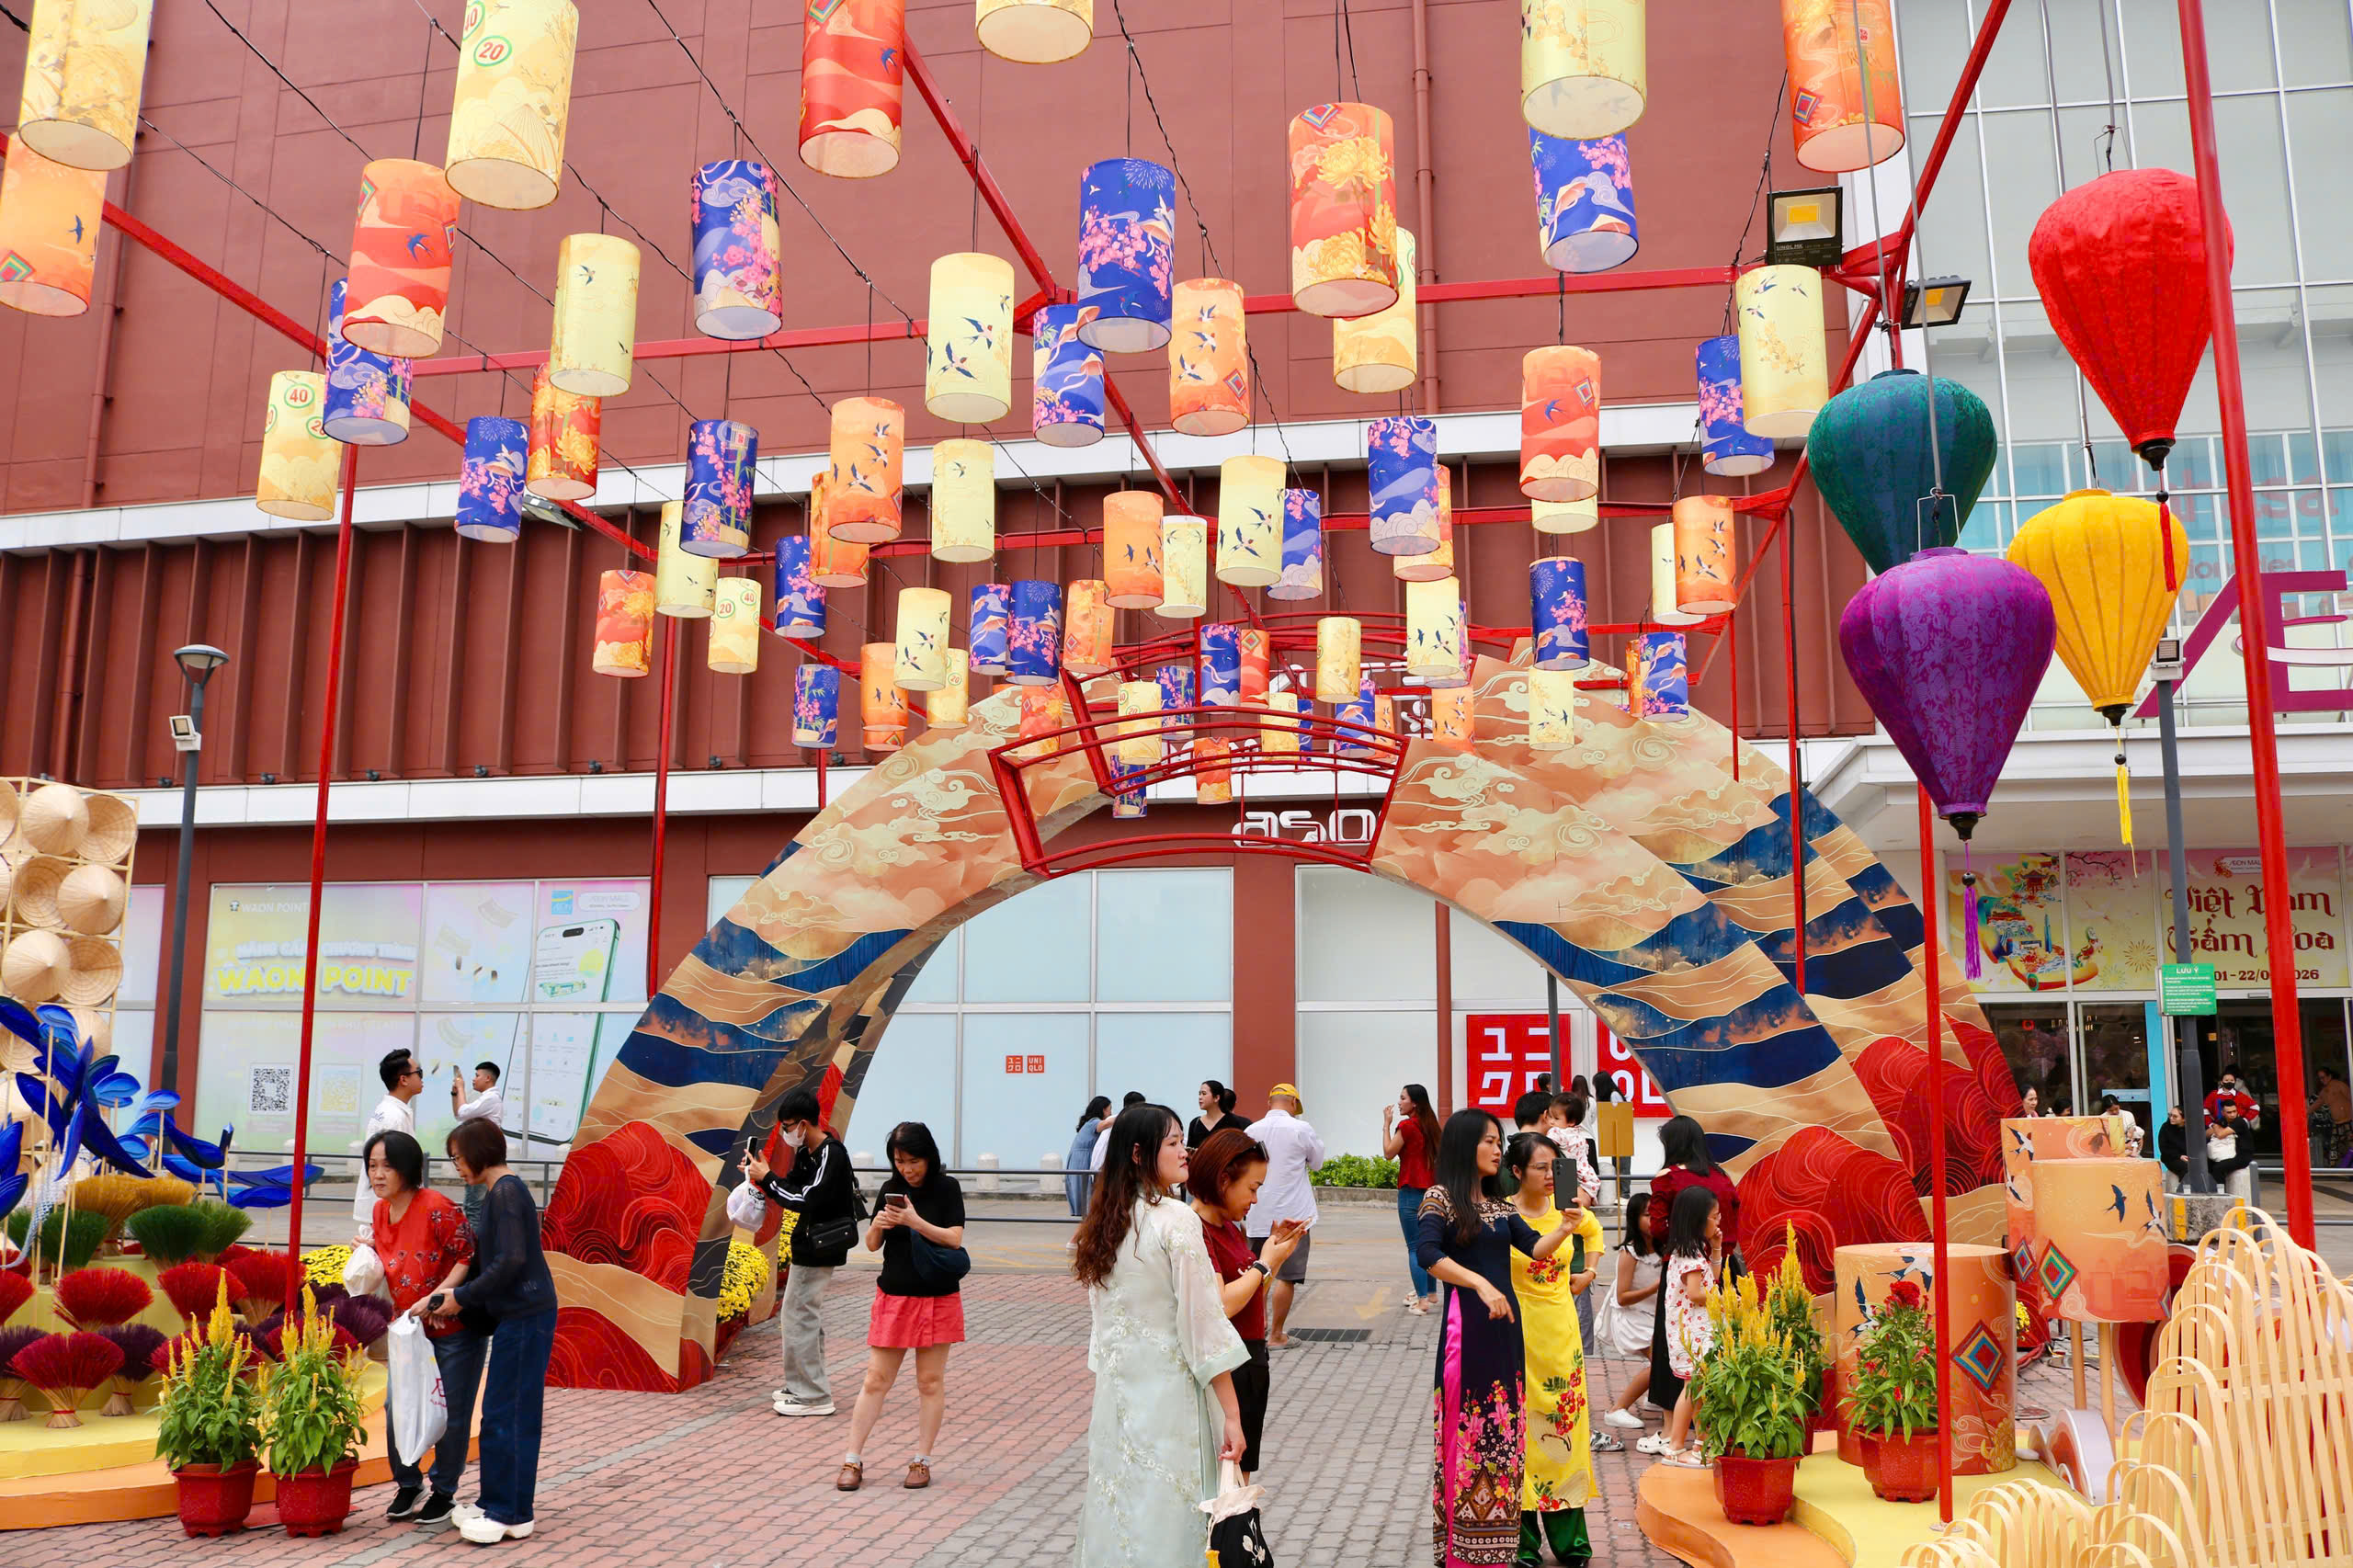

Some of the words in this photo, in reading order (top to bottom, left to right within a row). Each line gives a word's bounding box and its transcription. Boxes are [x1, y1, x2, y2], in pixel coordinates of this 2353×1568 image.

[478, 41, 505, 61] 20
[290, 389, 309, 403] 40
[719, 602, 733, 614] 20
[217, 965, 304, 992] WAON
[323, 966, 414, 993] POINT
